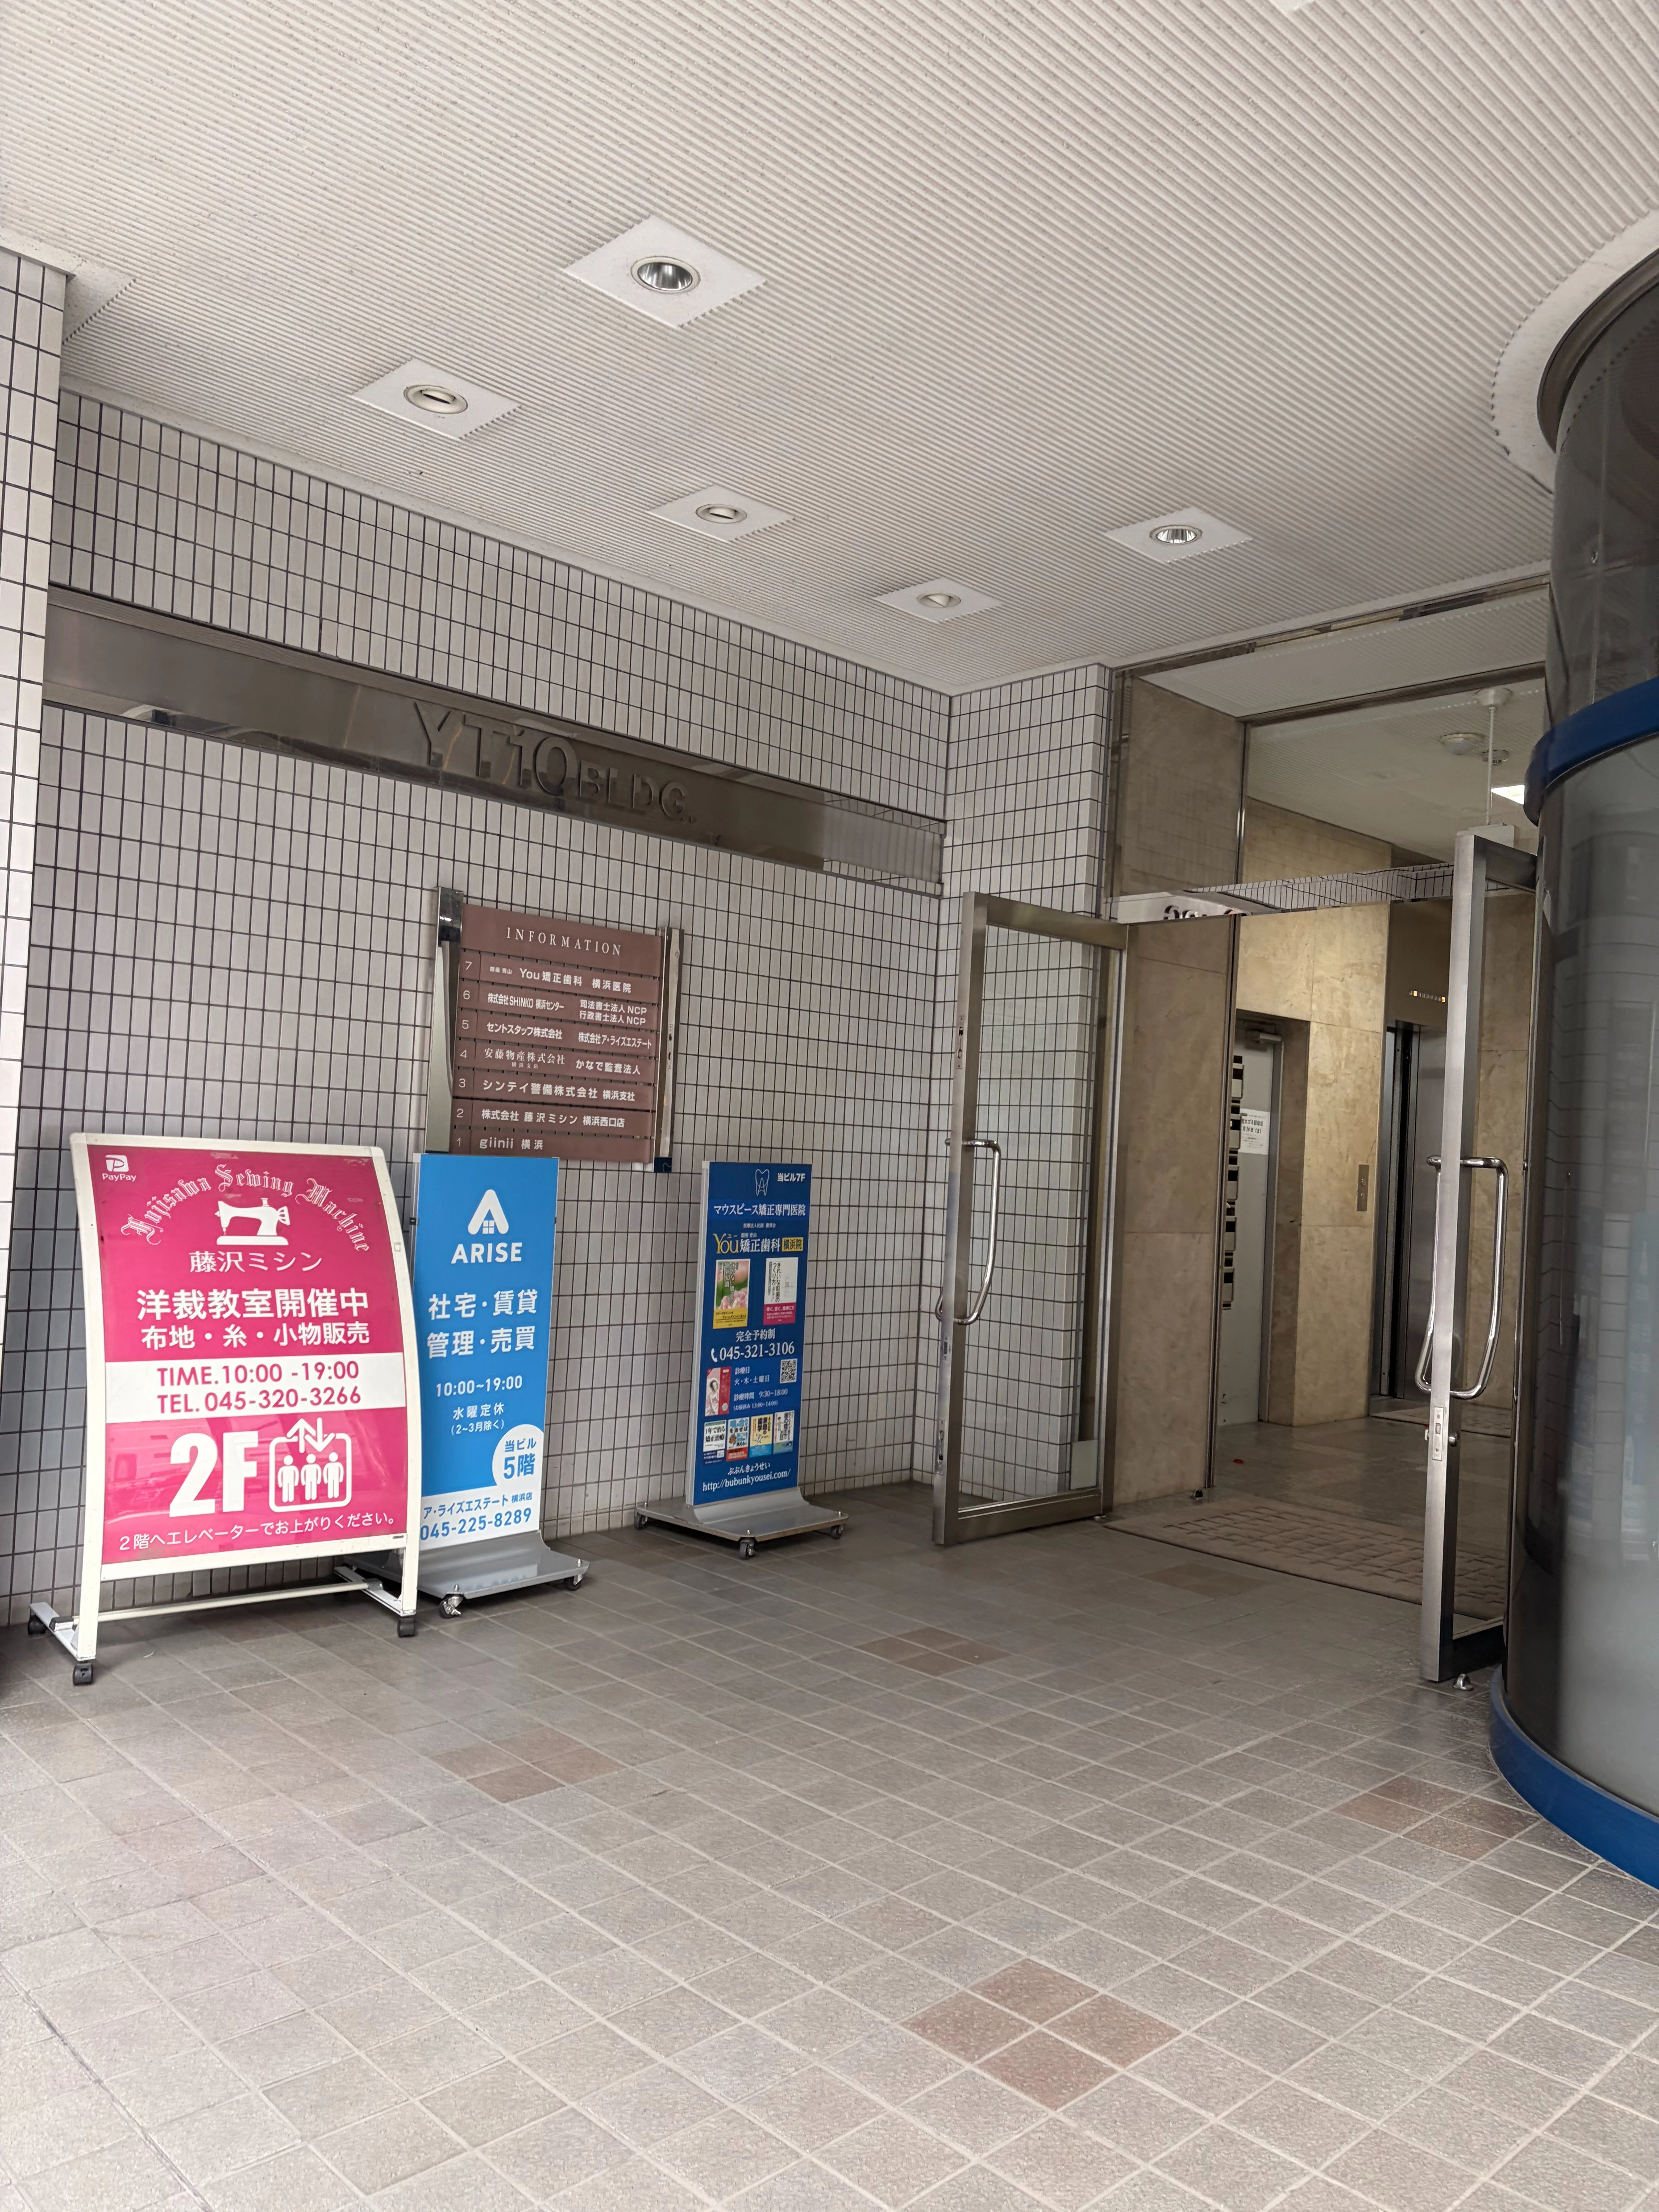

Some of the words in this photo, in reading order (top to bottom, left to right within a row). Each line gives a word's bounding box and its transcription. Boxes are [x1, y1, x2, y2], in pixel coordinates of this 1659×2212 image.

[506, 927, 622, 956] INFORMATION
[465, 962, 472, 970] 7
[592, 978, 631, 994] 横浜医院
[463, 991, 470, 1000] 6
[536, 999, 564, 1011] 横浜センター
[580, 999, 625, 1013] 司法書士法人
[628, 1006, 647, 1015] NCP
[579, 1010, 624, 1024] 行政書士法人
[626, 1017, 646, 1025] NCP
[462, 1020, 469, 1029] 5
[486, 1022, 563, 1040] セントスタッフ株式会社
[460, 1050, 467, 1059] 4
[484, 1048, 565, 1065] 安藤物産株式会社
[576, 1060, 641, 1075] かなで監査法人
[459, 1079, 466, 1088] 3
[603, 1089, 635, 1102] 横浜支社
[457, 1109, 464, 1118] 2
[481, 1109, 519, 1122] 株式会社
[524, 1111, 578, 1125] 藤沢ミシン
[583, 1115, 625, 1128] 横浜西口店
[457, 1138, 461, 1147] 1
[479, 1137, 513, 1150] giinii
[521, 1138, 543, 1150] 横浜
[102, 1173, 136, 1182] PayPay
[777, 1173, 806, 1182] 当ビル7F
[215, 1163, 294, 1198] Sewing
[295, 1178, 369, 1252] Machine
[714, 1203, 806, 1216] マウスピース矯正専門医院
[189, 1250, 323, 1274] 藤沢ミシン
[450, 1242, 522, 1264] ARISE
[136, 1287, 369, 1321] 洋裁教室開催中
[428, 1288, 538, 1321] 社宅・賃貸
[141, 1322, 370, 1350] 布地・糸・小物販売
[427, 1326, 535, 1359] 管理・売買
[736, 1328, 775, 1342] 完全予約制
[719, 1341, 795, 1361] 045-321-3106
[735, 1366, 750, 1375] 診療日
[452, 1402, 505, 1420] 水曜定休
[504, 1437, 537, 1453] 当ビル
[169, 1431, 259, 1518] 2F
[503, 1453, 536, 1479] 5階
[727, 1462, 771, 1475] ぶぶんきょうせい
[702, 1468, 791, 1492] http://bubunkyousei.com/
[424, 1494, 508, 1519] ア・ライズエステート
[511, 1492, 532, 1503] 横浜店
[420, 1507, 532, 1540] 045-225-8289
